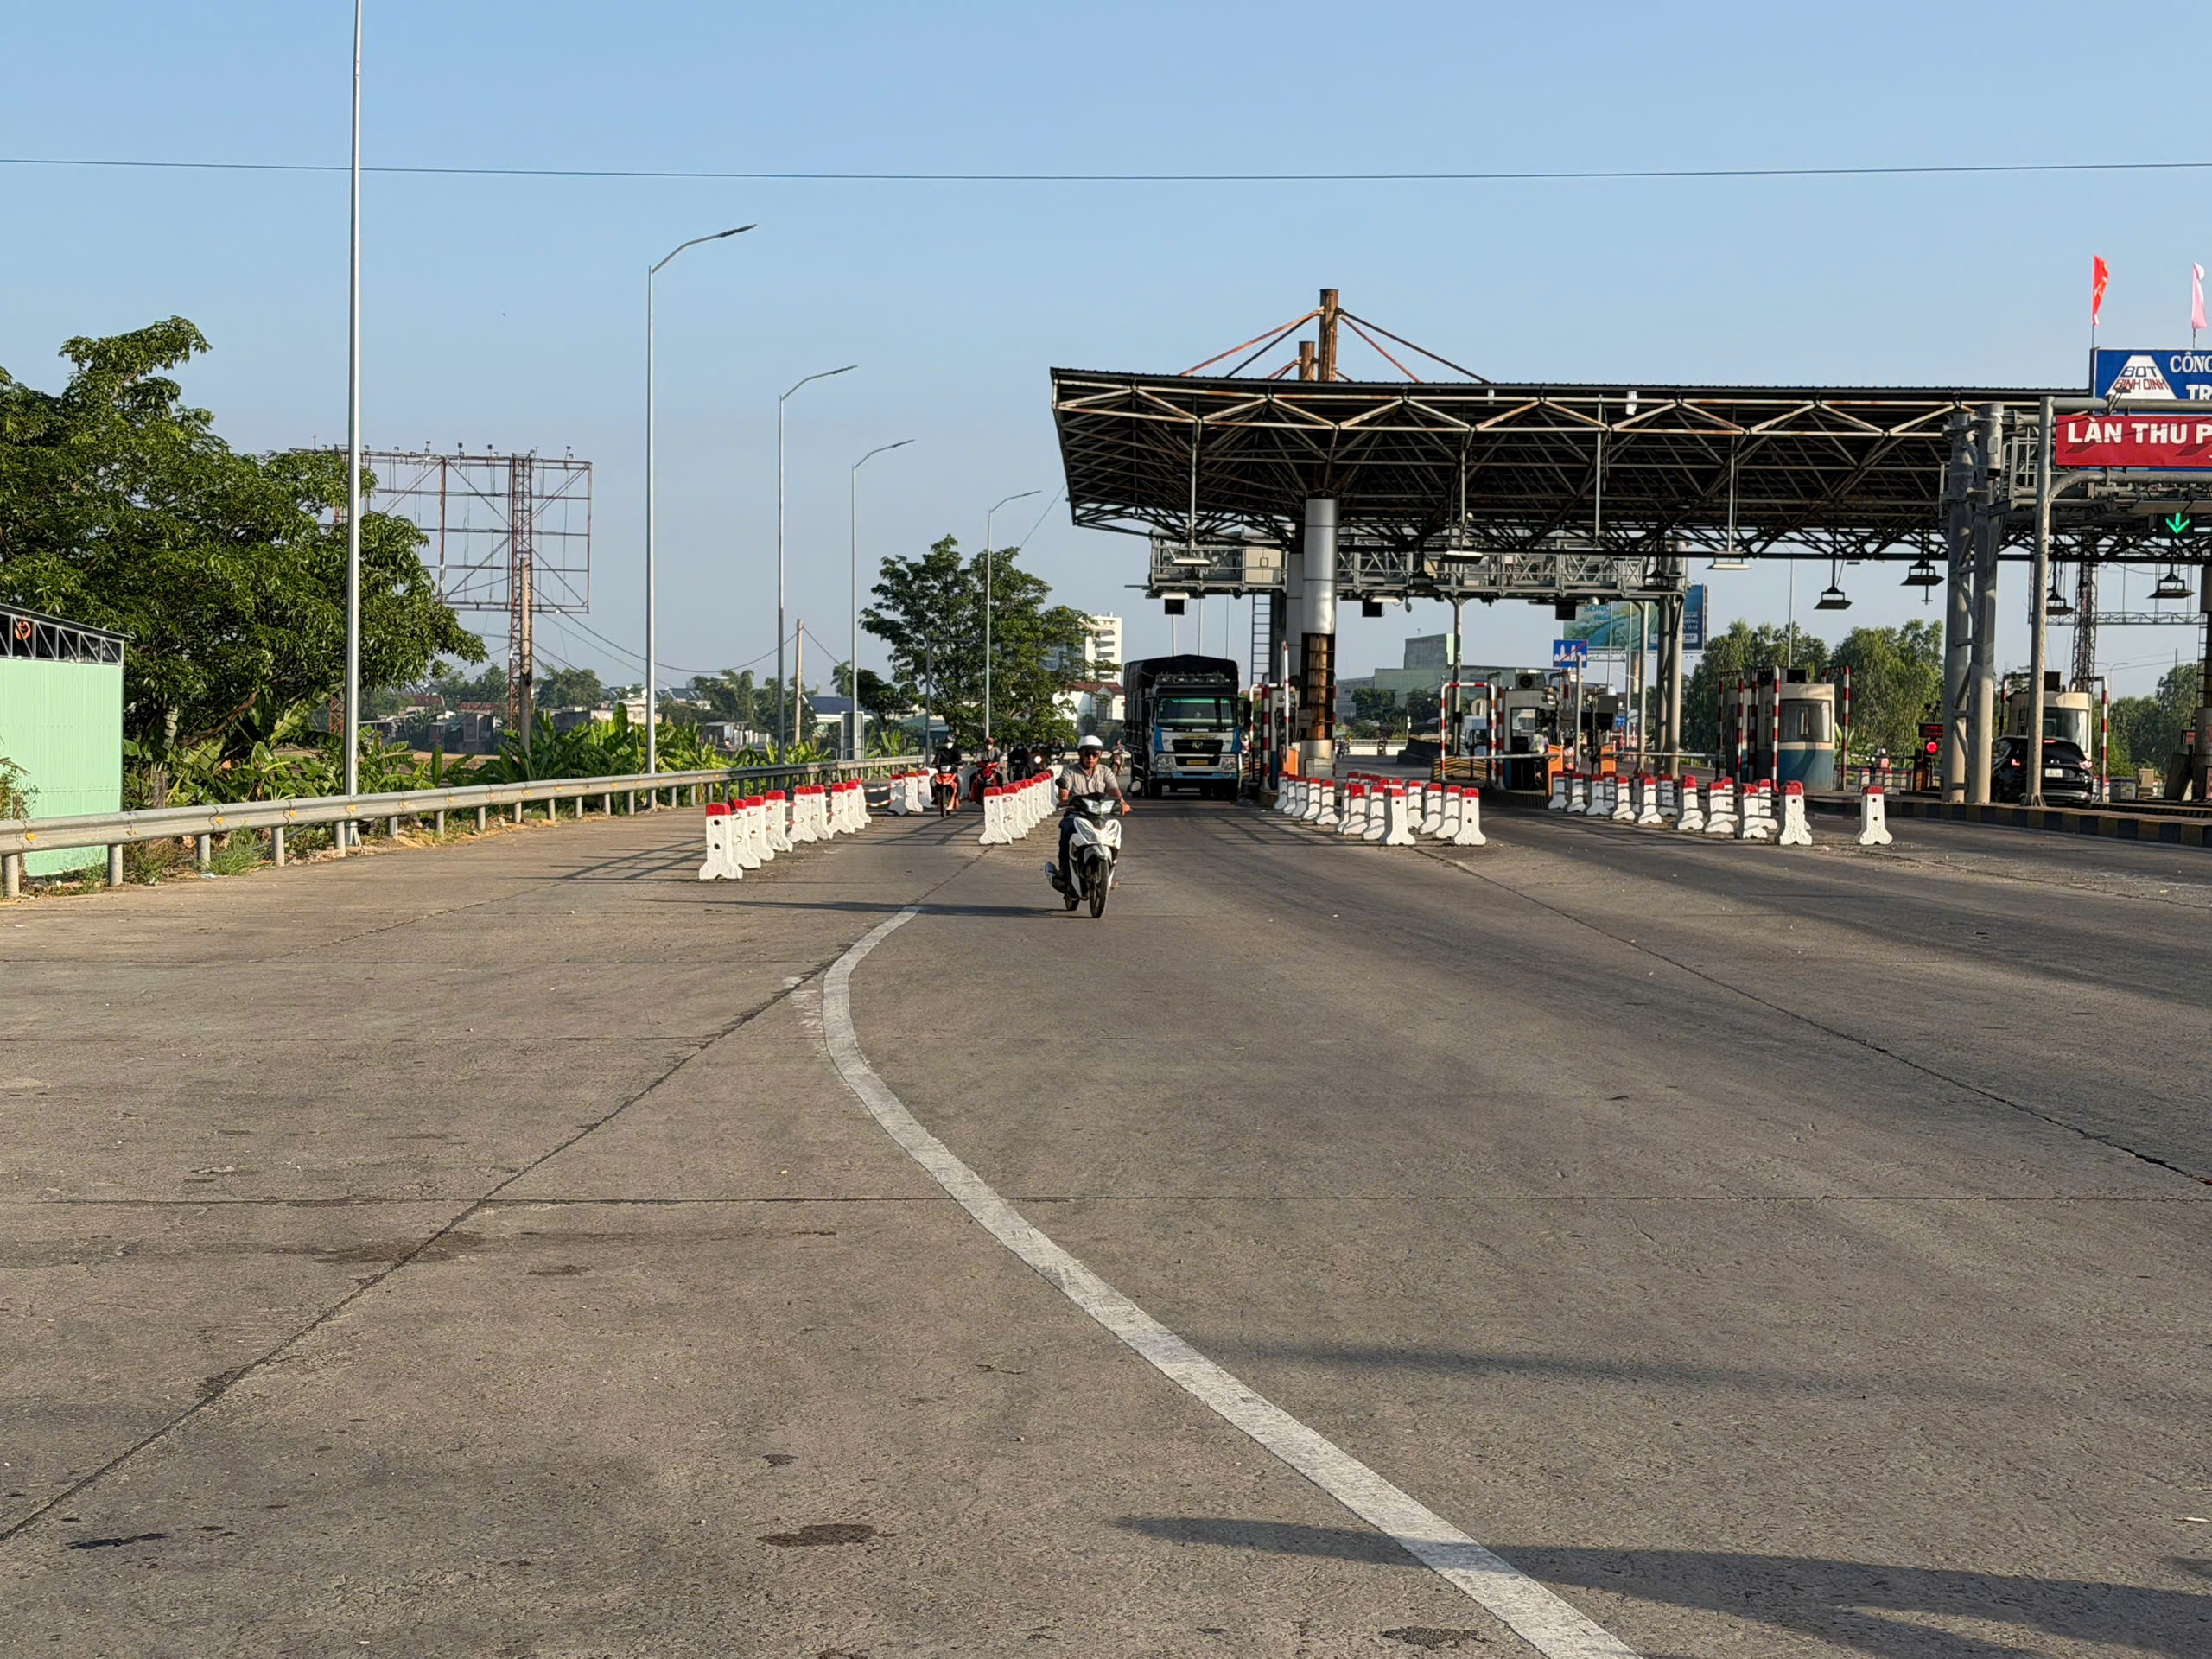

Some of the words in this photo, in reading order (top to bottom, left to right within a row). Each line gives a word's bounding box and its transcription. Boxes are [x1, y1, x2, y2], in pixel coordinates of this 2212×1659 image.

[2120, 365, 2158, 378] BOT
[2067, 416, 2122, 443] LÀN
[2131, 423, 2188, 444] THU
